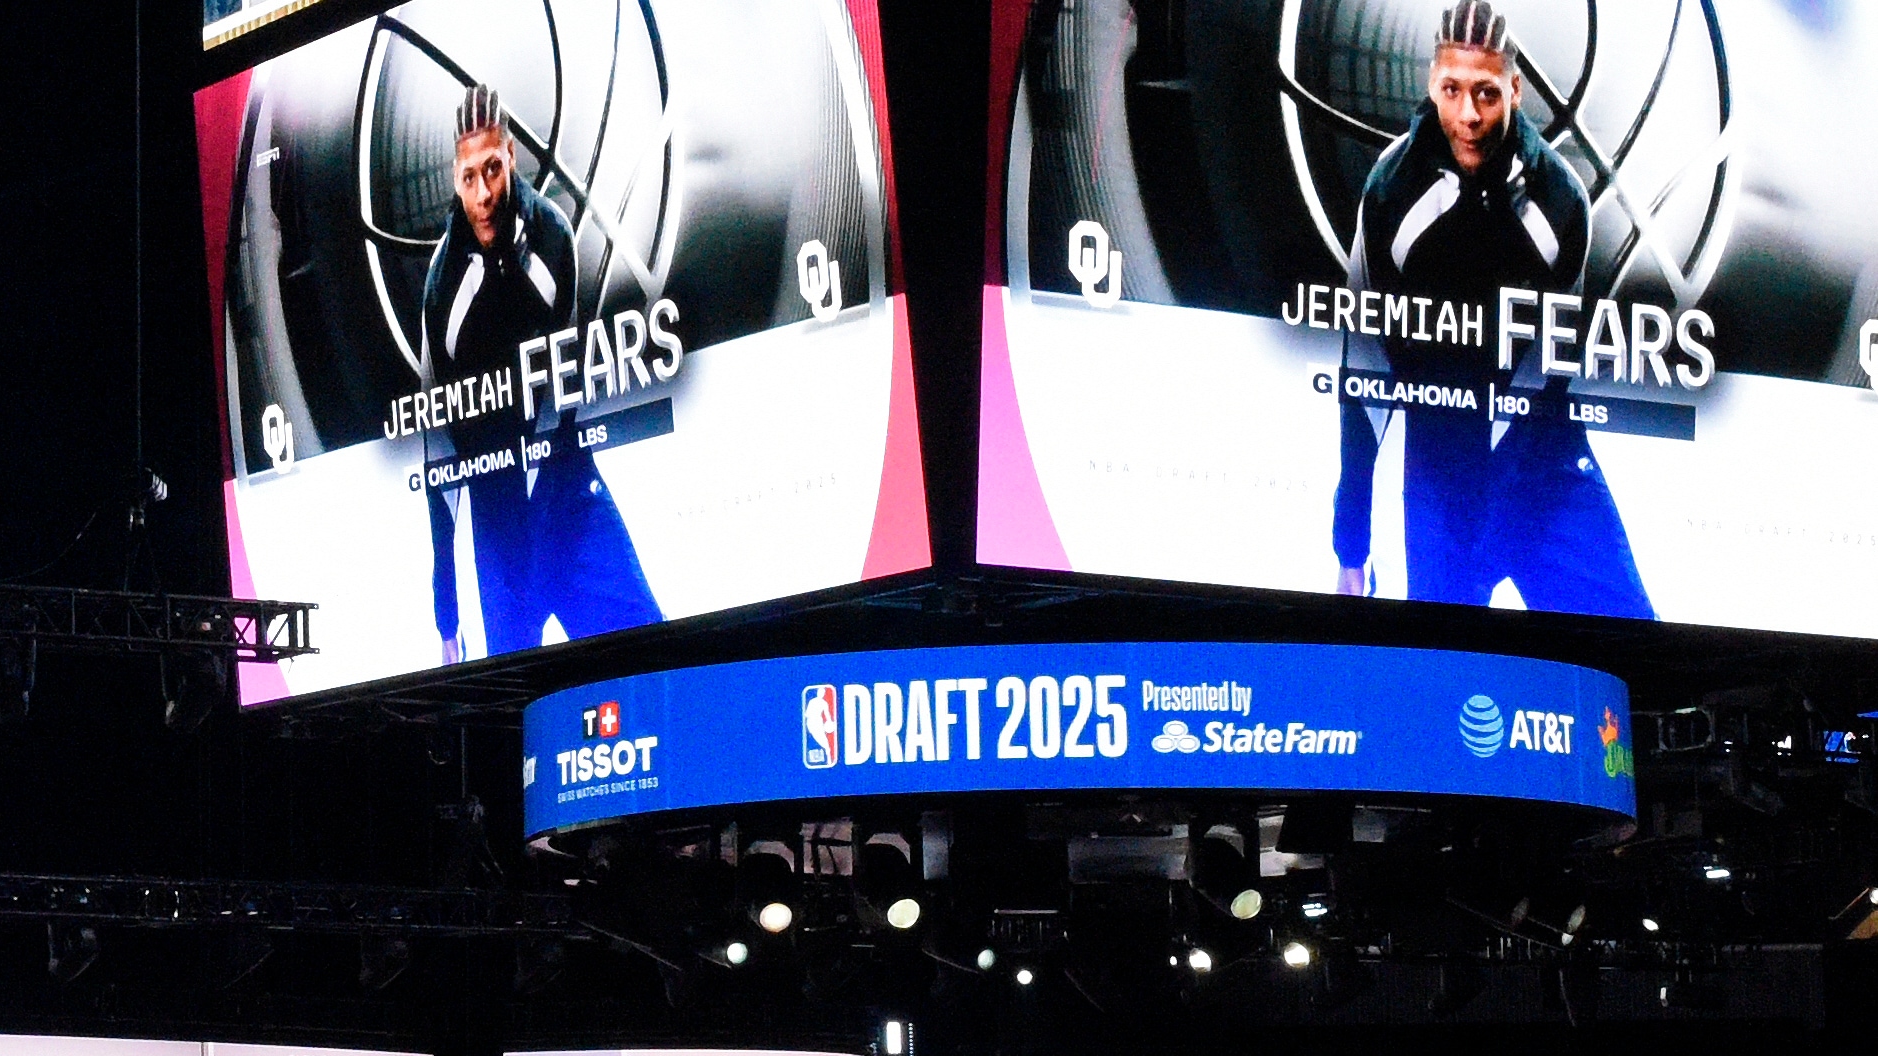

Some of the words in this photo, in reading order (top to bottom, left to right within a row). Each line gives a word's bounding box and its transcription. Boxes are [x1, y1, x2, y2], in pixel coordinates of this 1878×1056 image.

[1281, 282, 1483, 347] JEREMIAH
[1497, 286, 1716, 389] FEARS
[384, 367, 513, 440] JEREMIAH
[519, 298, 683, 421] FEARS
[1312, 372, 1333, 395] G
[1344, 376, 1478, 411] OKLAHOMA
[1495, 394, 1530, 416] 180
[1569, 402, 1609, 424] LBS
[409, 473, 422, 492] G
[428, 448, 515, 488] OKLAHOMA
[526, 440, 551, 462] 180
[578, 425, 608, 448] LBS
[843, 678, 987, 765] DRAFT
[995, 675, 1128, 759] 2025
[1142, 680, 1229, 712] Presented
[1231, 680, 1252, 717] by
[1509, 710, 1575, 754] AT&T
[557, 736, 658, 785] TISSOT
[610, 779, 636, 794] SINCE
[638, 777, 659, 790] 1853
